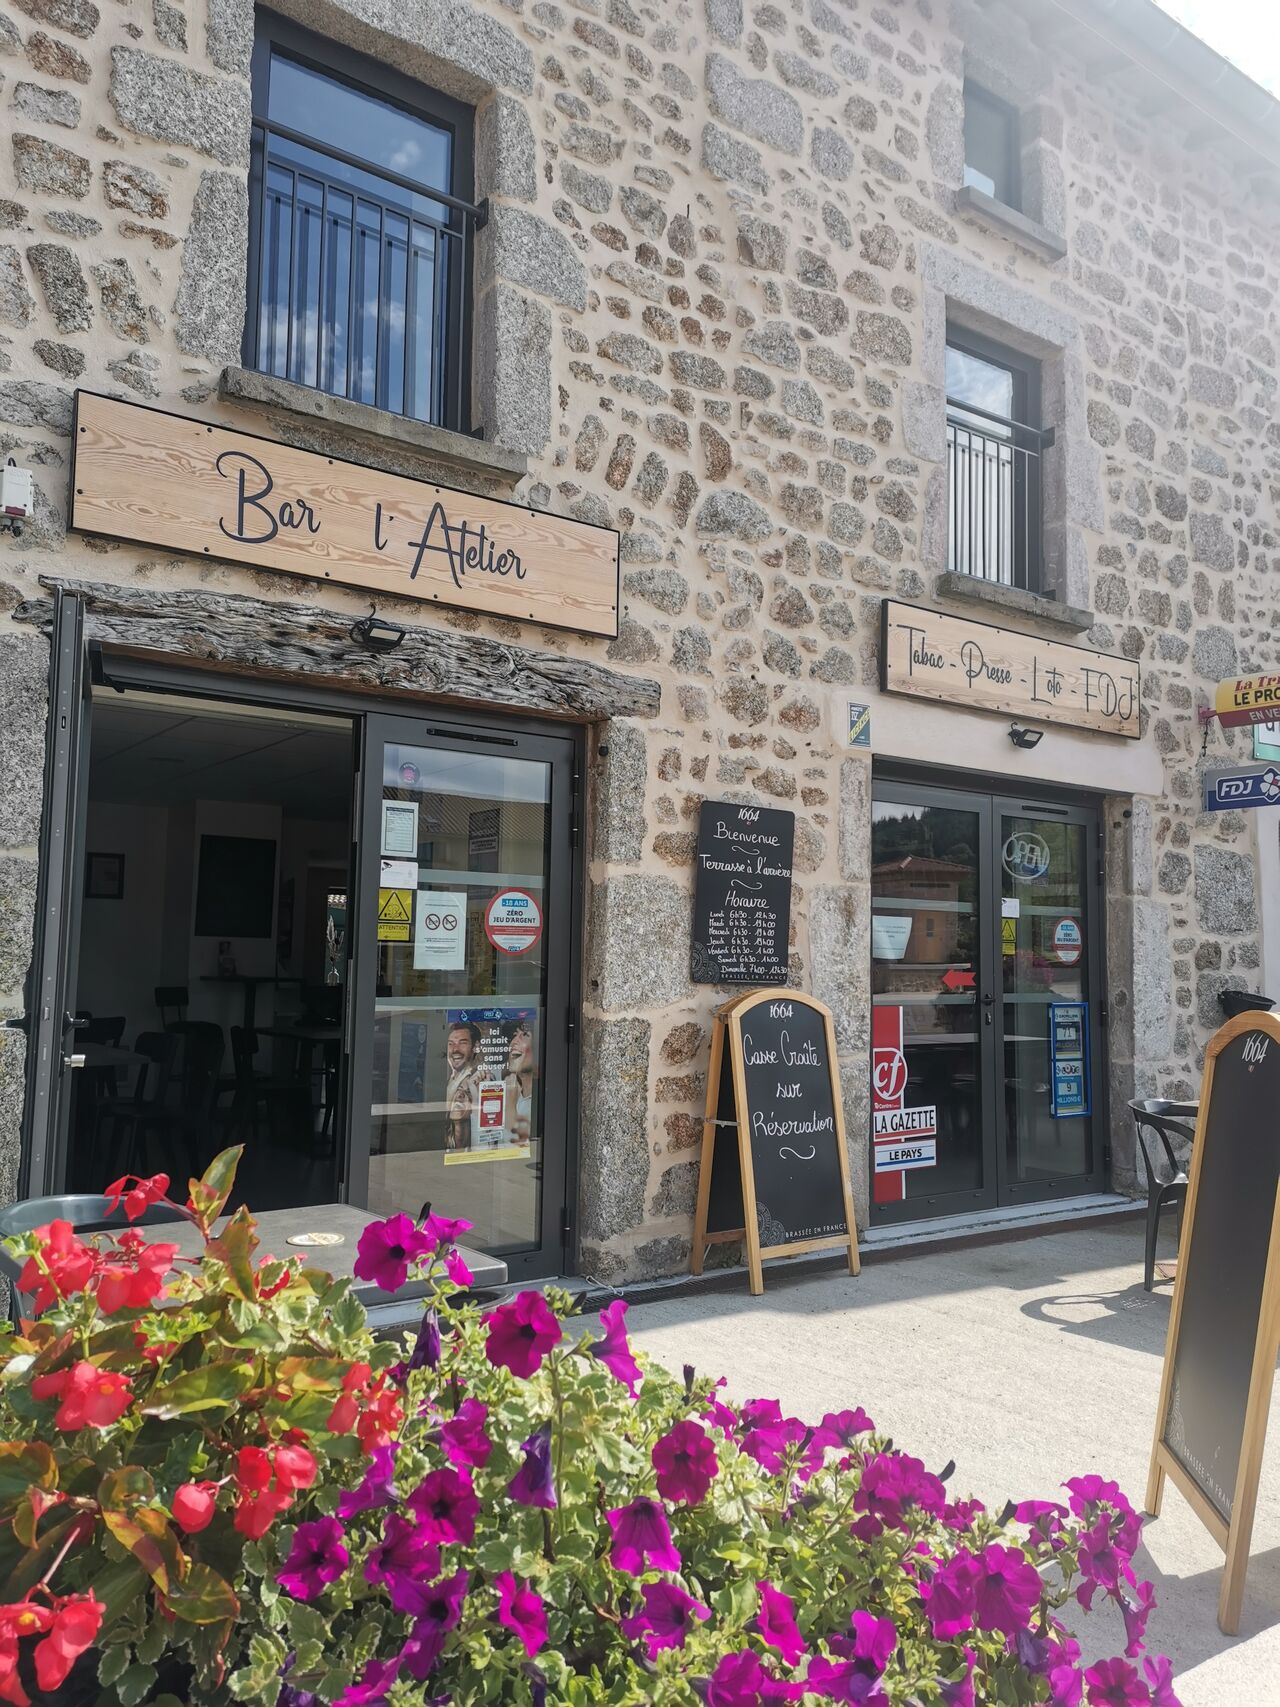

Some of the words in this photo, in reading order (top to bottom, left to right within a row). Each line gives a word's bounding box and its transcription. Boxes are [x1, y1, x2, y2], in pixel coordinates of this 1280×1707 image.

[216, 451, 321, 543] Bar
[408, 502, 527, 589] Atelier
[896, 623, 945, 676] Tabac
[960, 640, 1012, 688] Presse
[1030, 656, 1064, 706] Loto
[1080, 667, 1133, 720] FDJ
[1235, 680, 1253, 691] La
[1234, 692, 1250, 706] LE
[1249, 710, 1265, 721] EN
[1220, 779, 1253, 797] FDJ
[738, 807, 760, 822] 1664
[713, 820, 780, 847] Bienvenue
[699, 854, 745, 873] Terrasse
[747, 859, 753, 874] à
[725, 890, 770, 909] Horaire
[507, 909, 523, 917] ZÉRO
[769, 1002, 794, 1019] 1664
[489, 1027, 500, 1035] Ici
[492, 1036, 508, 1044] sait
[743, 1033, 779, 1066] Casse
[780, 1030, 822, 1066] Croûte
[475, 1045, 512, 1053] s'amuser
[1241, 1033, 1270, 1064] 1664
[776, 1082, 803, 1098] sur
[752, 1109, 834, 1137] Réservation
[874, 1115, 888, 1134] LA
[890, 1109, 935, 1132] GAZETTE
[889, 1151, 901, 1161] LE
[901, 1148, 923, 1160] PAYS
[814, 1226, 821, 1234] EN
[823, 1222, 846, 1232] FRANCE
